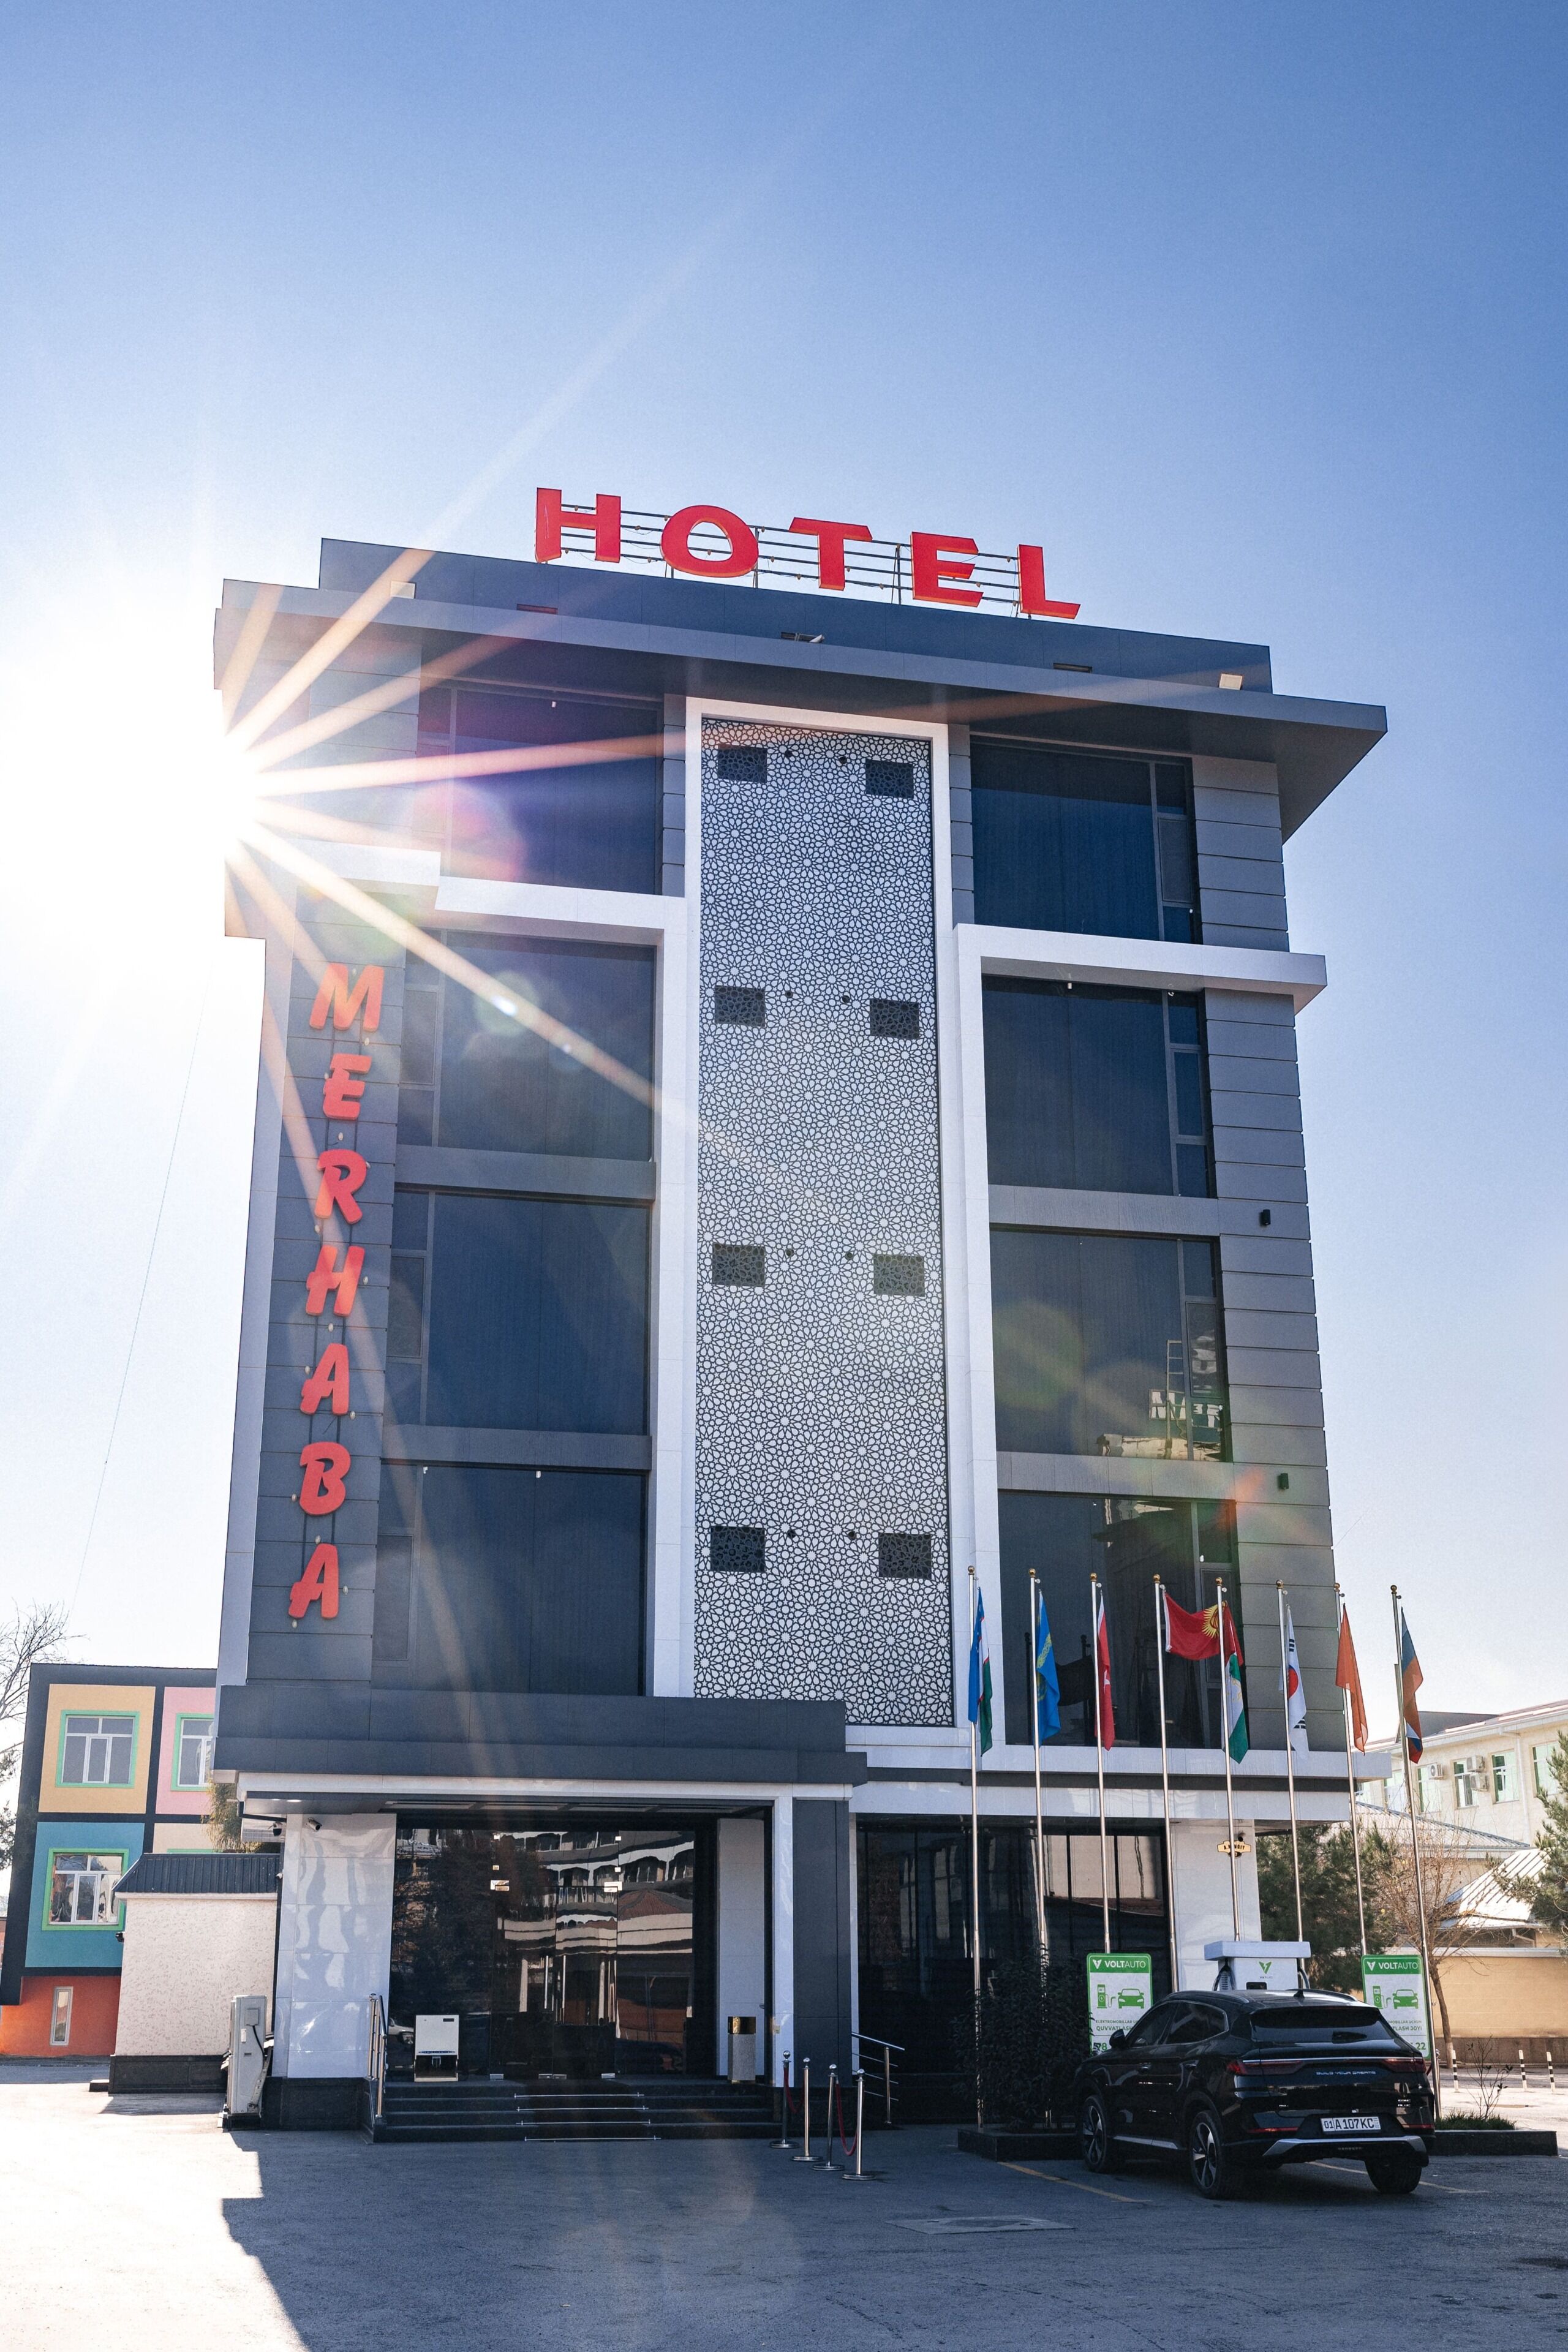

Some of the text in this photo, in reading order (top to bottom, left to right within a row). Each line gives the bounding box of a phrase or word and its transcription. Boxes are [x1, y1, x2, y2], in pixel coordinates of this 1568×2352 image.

[534, 487, 1080, 619] HOTEL
[288, 963, 385, 1619] MERHABA
[1324, 2120, 1334, 2129] 01
